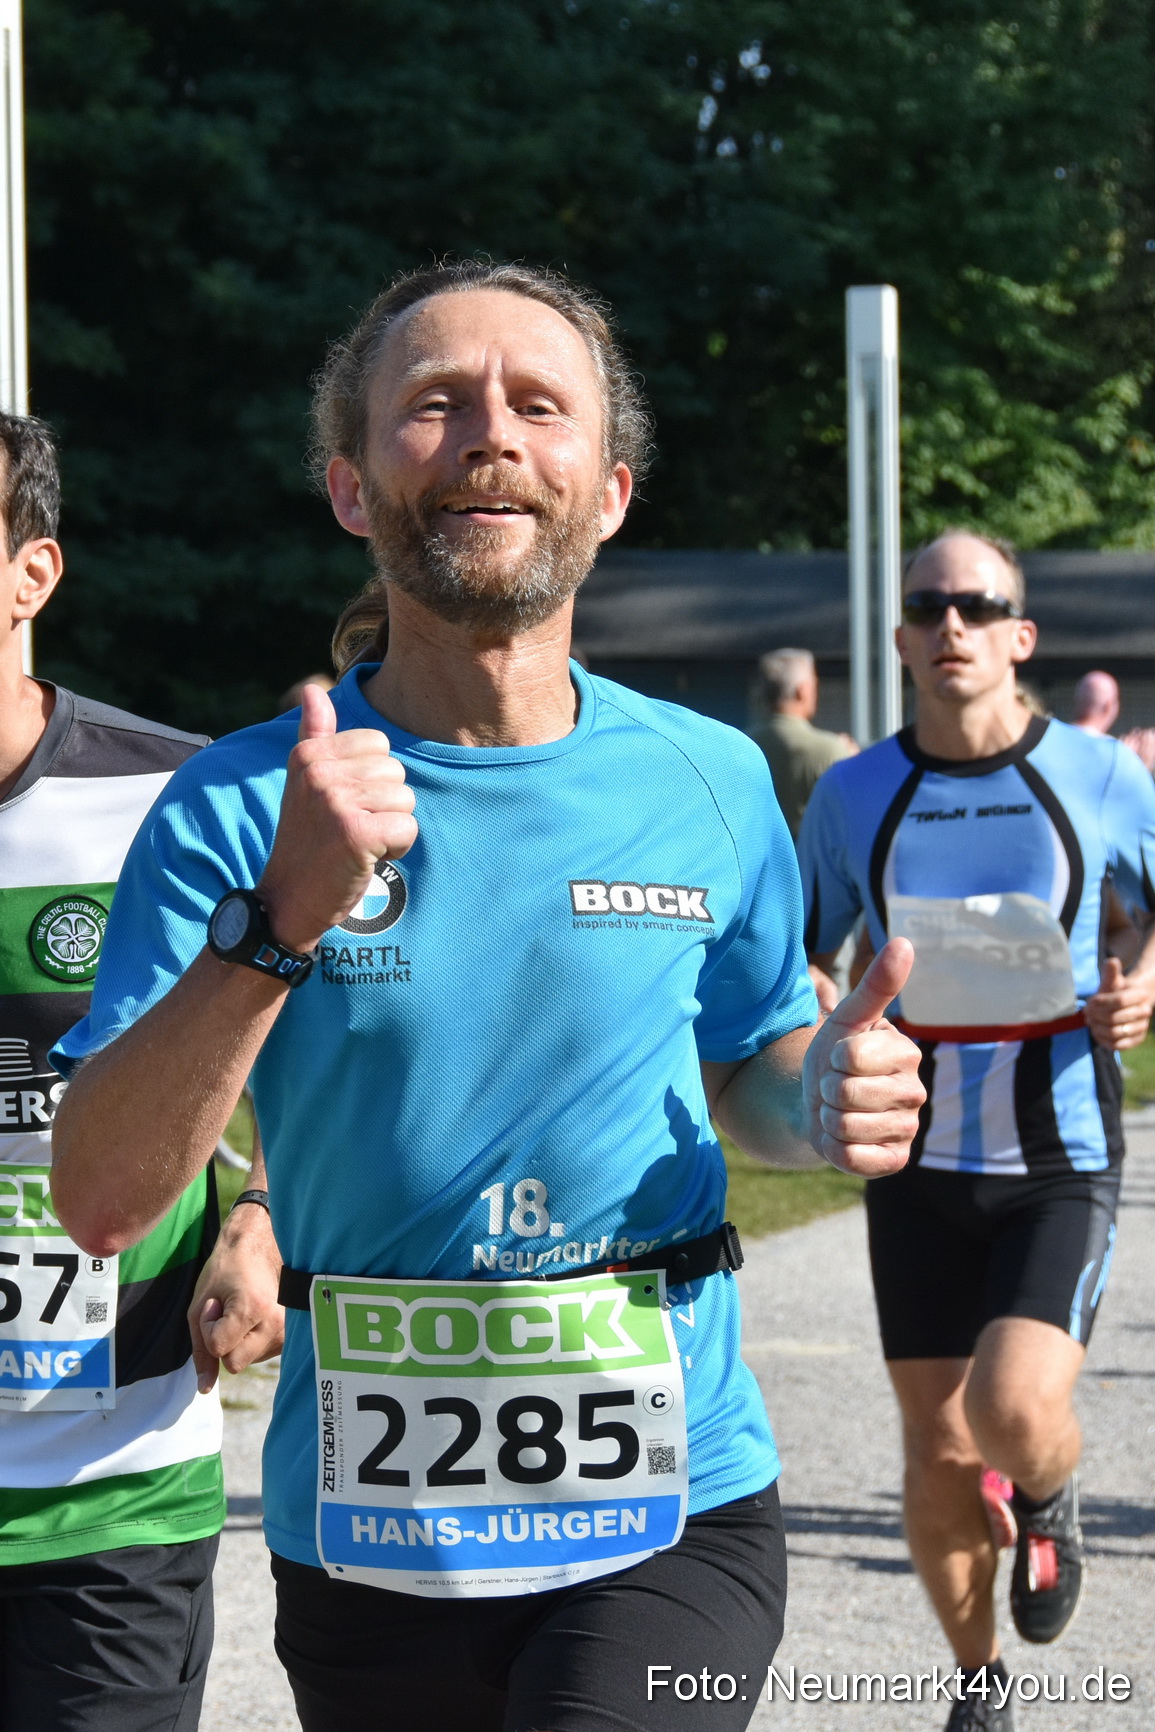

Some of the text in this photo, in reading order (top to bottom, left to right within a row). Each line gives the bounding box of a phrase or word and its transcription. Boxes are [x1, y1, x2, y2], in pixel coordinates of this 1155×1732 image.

[63, 902, 100, 919] FOOTBALL
[570, 882, 712, 921] BOCK
[41, 905, 63, 925] CELTIC
[37, 926, 46, 940] THE
[573, 919, 621, 930] inspired
[626, 919, 639, 931] by
[643, 921, 674, 932] smart
[321, 946, 410, 967] PARTL
[67, 965, 85, 974] 1888
[321, 968, 411, 984] Neumarkt
[480, 1178, 566, 1238] 18.
[472, 1236, 661, 1273] Neumarkter
[92, 1260, 104, 1271] B
[342, 1297, 629, 1358] BOCK
[651, 1392, 666, 1408] C
[356, 1389, 640, 1487] 2285
[351, 1508, 647, 1546] HANS-JÜRGEN
